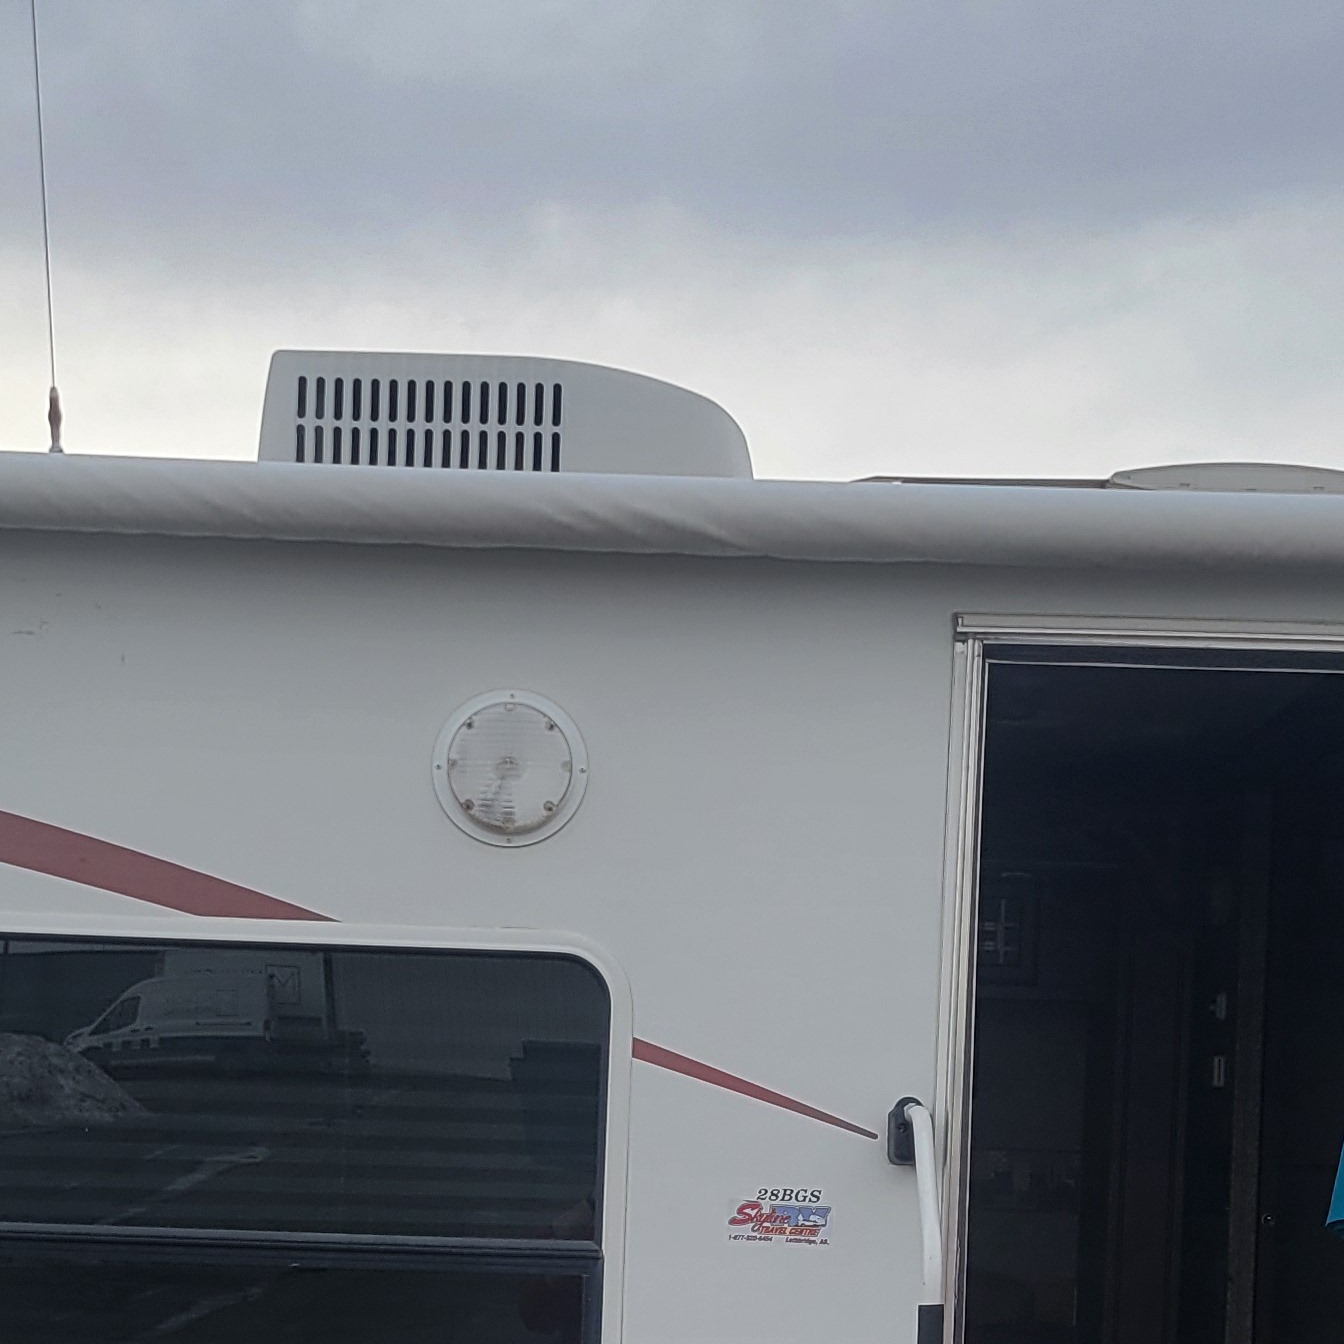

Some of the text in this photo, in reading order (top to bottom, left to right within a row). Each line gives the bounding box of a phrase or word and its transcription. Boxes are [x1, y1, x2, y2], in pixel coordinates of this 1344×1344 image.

[756, 1188, 822, 1203] 28BGS
[728, 1200, 833, 1232] Skyline RV
